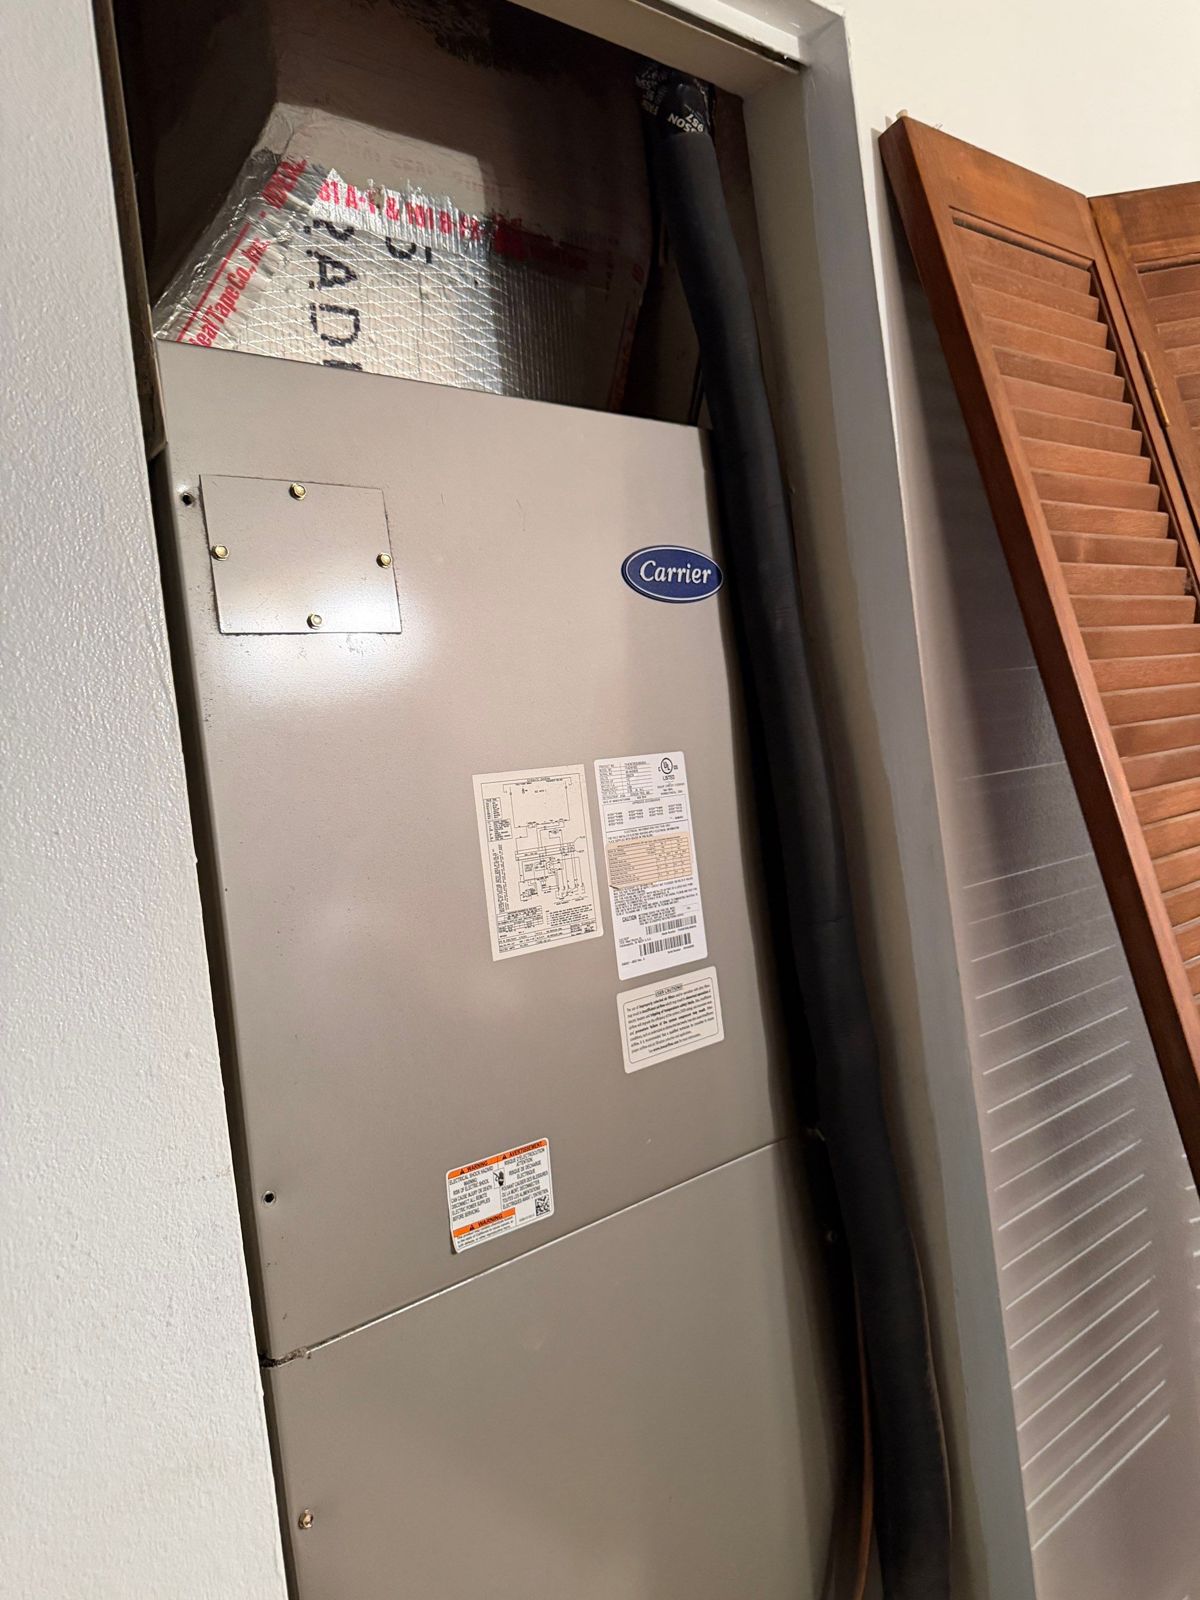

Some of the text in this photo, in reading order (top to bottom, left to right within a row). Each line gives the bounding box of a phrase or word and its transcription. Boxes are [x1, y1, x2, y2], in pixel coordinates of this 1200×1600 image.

[640, 560, 711, 583] Carrier
[467, 1160, 488, 1171] WARNING
[478, 1214, 502, 1227] WARNING
